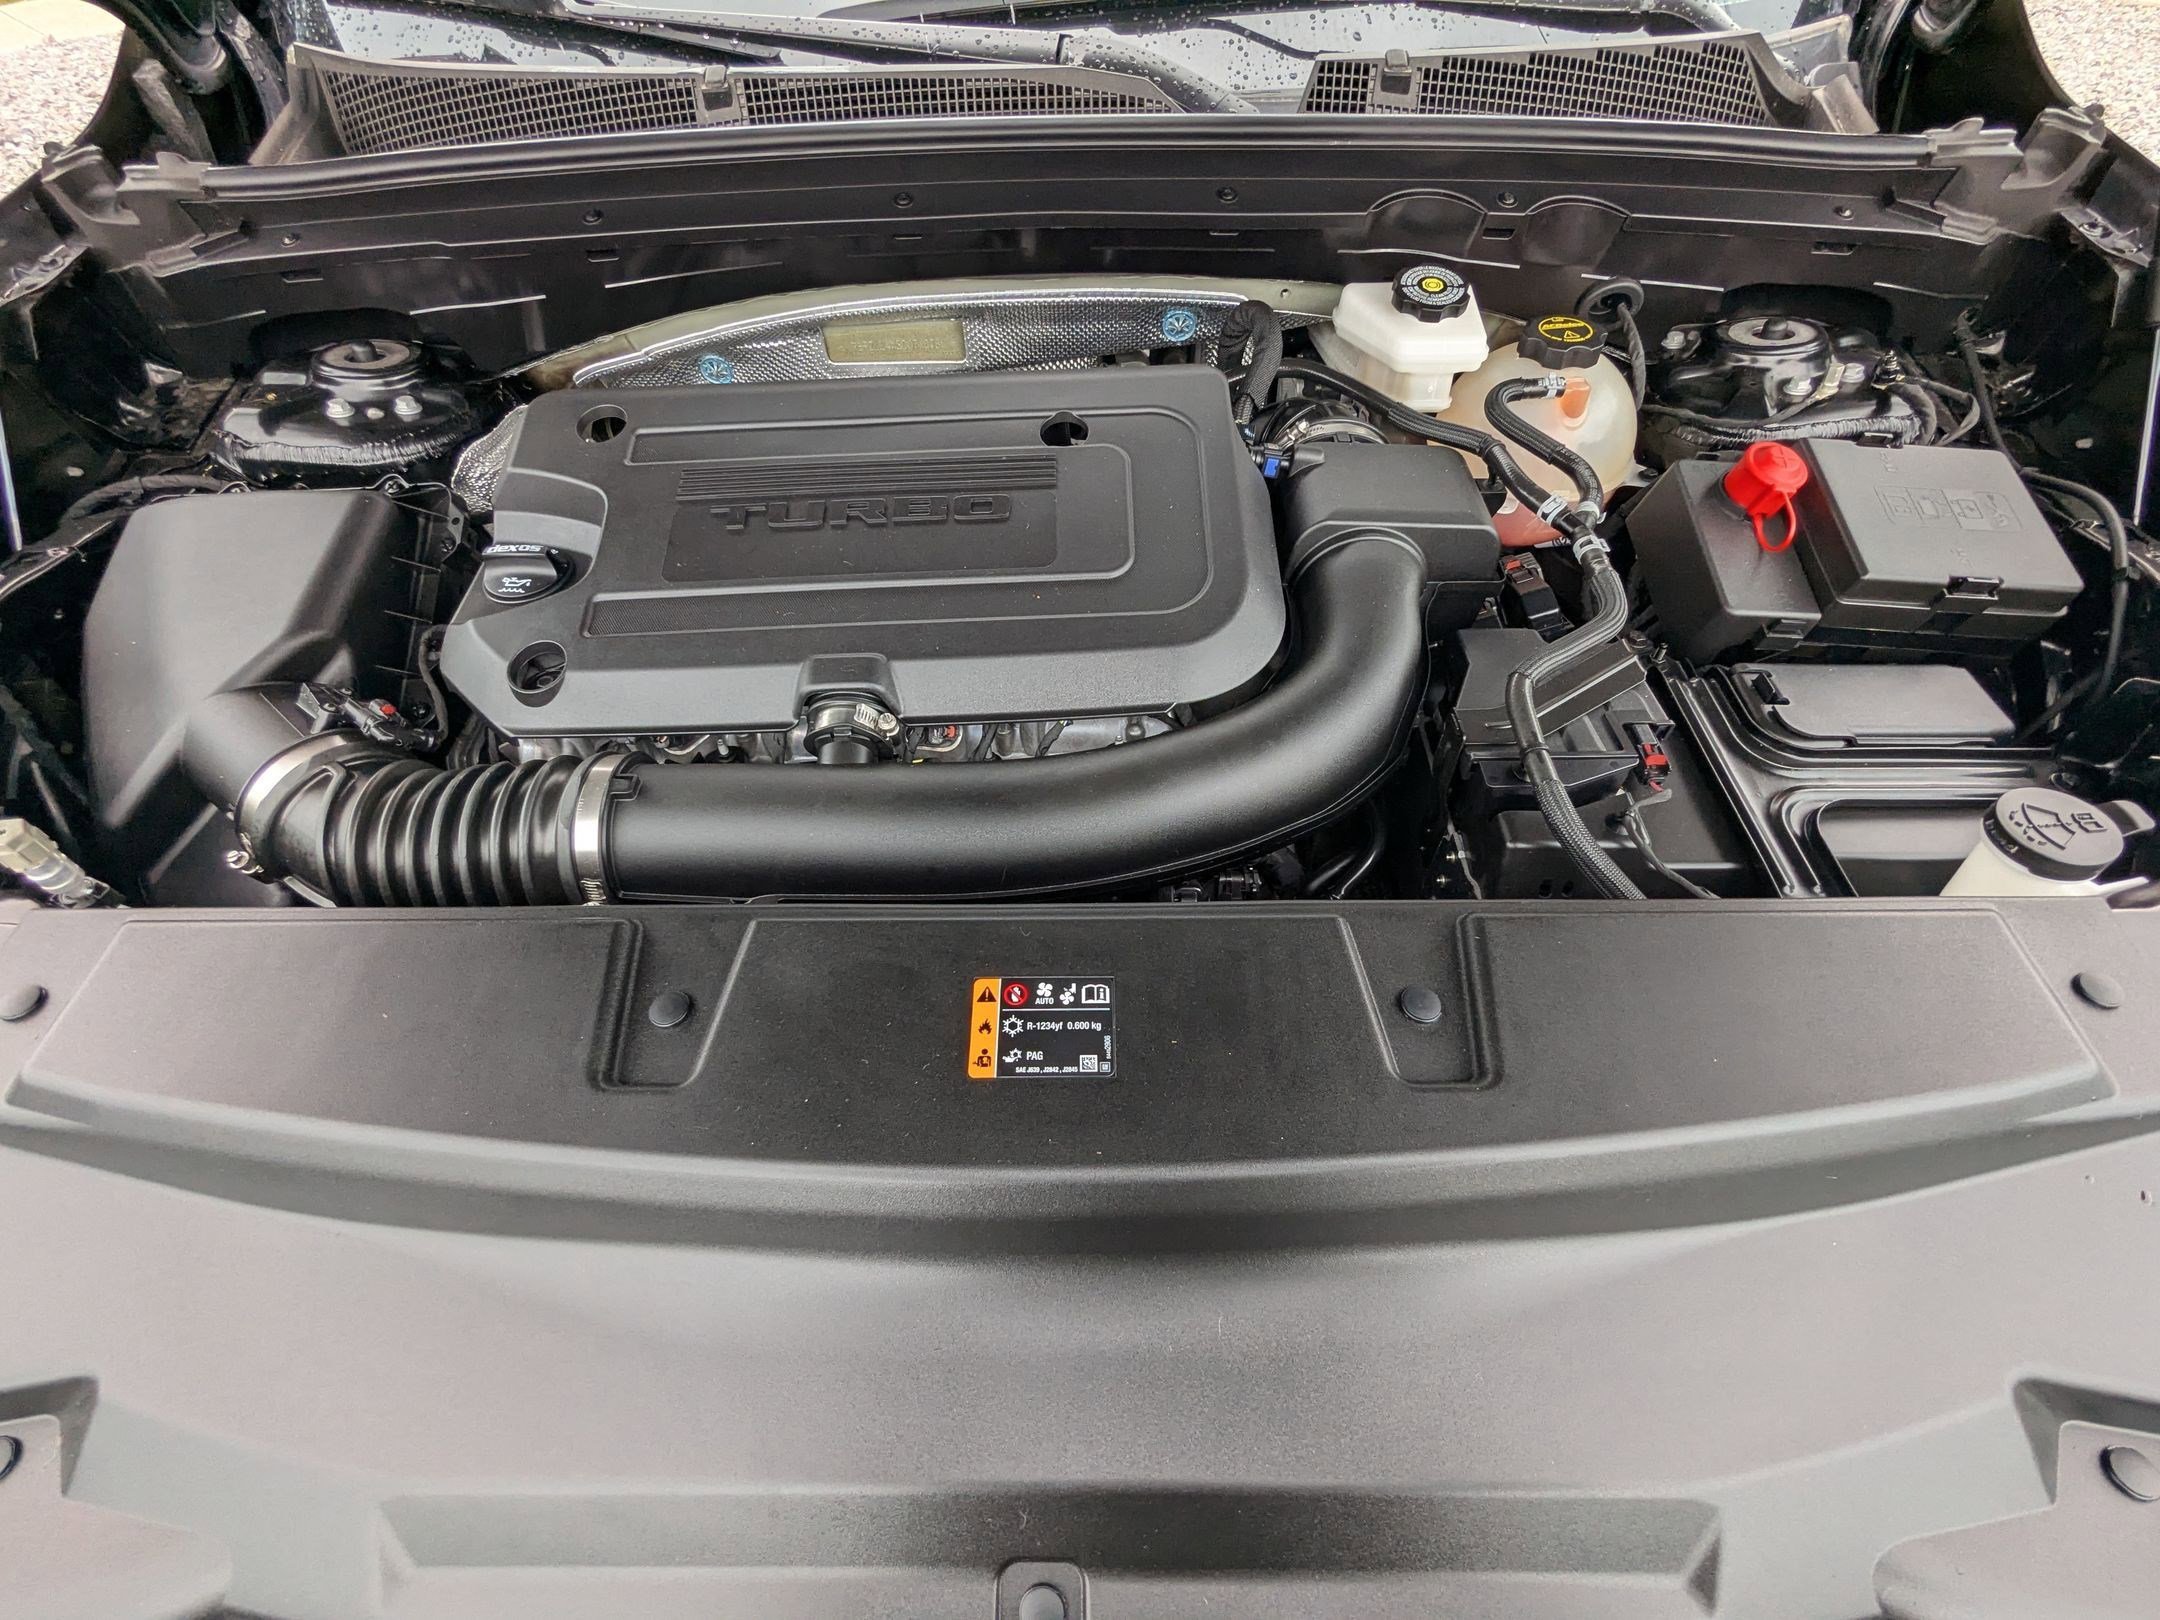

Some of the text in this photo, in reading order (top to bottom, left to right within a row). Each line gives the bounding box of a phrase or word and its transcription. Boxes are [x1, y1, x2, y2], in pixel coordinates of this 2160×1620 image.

[709, 493, 1012, 531] TURBO
[486, 544, 544, 553] dexos
[1035, 997, 1054, 1005] AUTO
[1026, 1021, 1102, 1031] R-1234yf 0.600 kg
[1026, 1051, 1044, 1061] PAG
